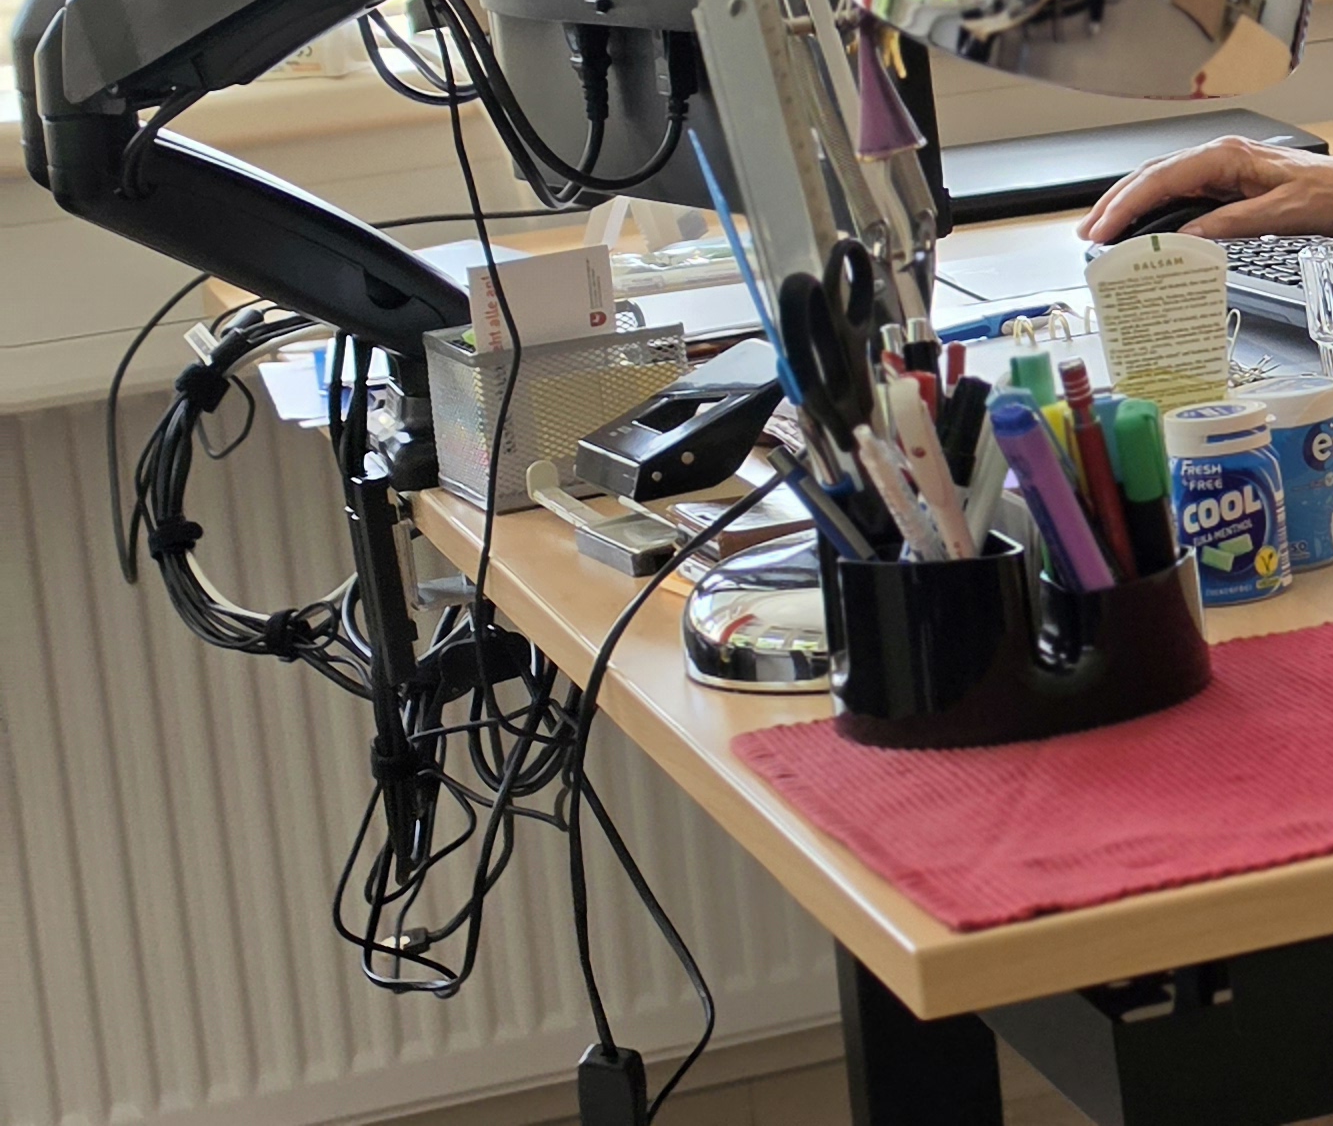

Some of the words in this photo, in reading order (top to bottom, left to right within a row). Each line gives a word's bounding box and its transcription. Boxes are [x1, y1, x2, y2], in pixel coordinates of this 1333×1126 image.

[1133, 257, 1184, 272] BALSAM
[1181, 459, 1222, 476] FRESH
[1189, 478, 1223, 491] FREE
[1183, 484, 1262, 534] COOL
